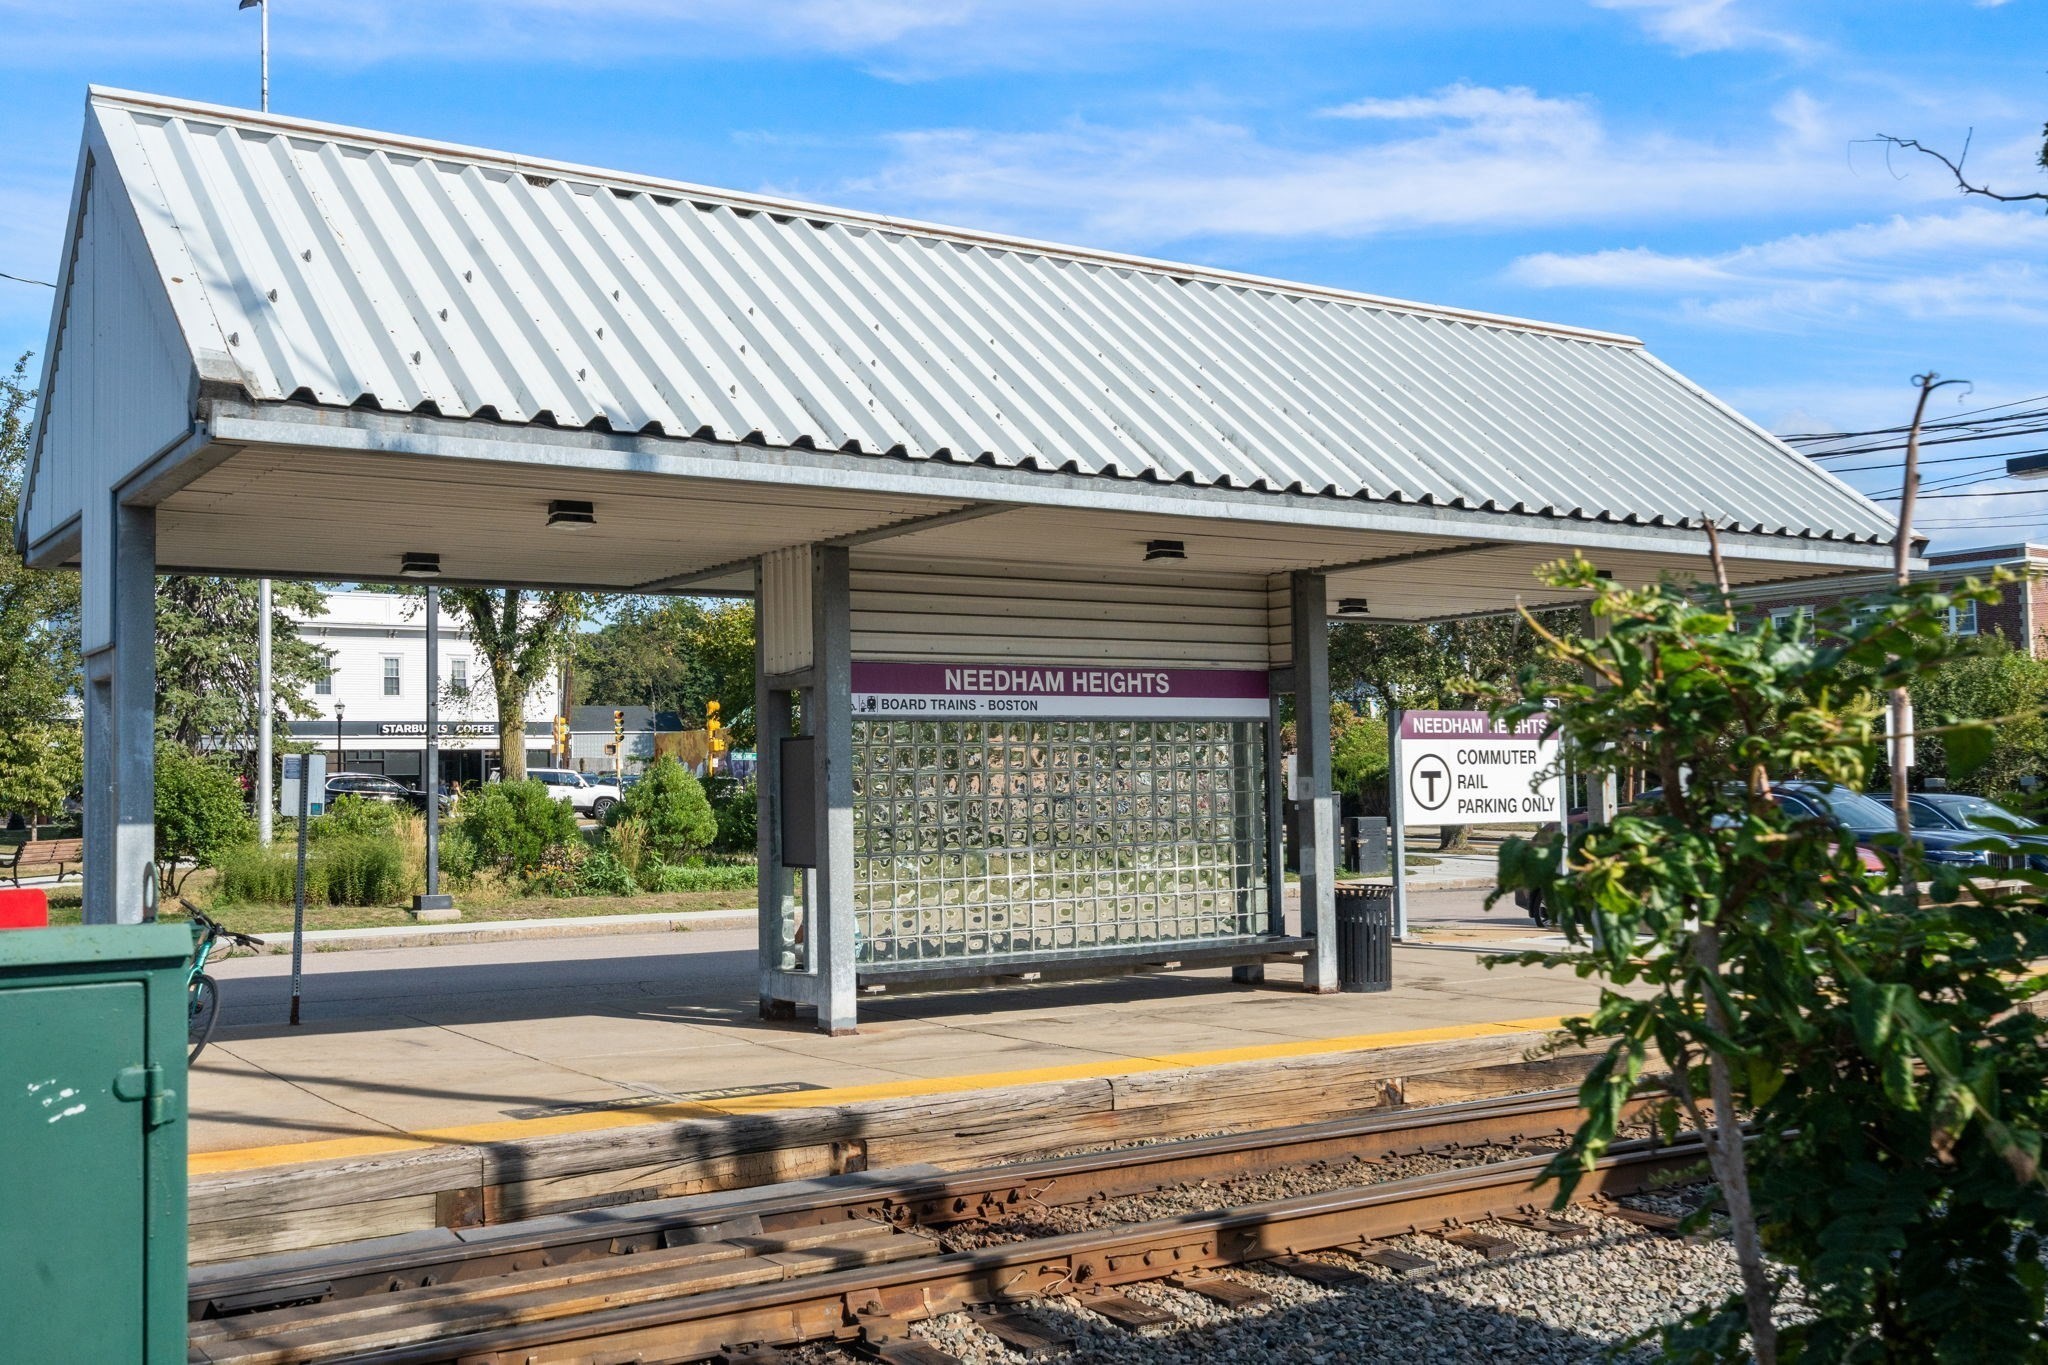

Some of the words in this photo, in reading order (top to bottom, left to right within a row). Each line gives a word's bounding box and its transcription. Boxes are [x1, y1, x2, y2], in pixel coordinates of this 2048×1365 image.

[944, 668, 1065, 692] NEEDHAM
[1072, 672, 1170, 694] HEIGHTS
[881, 698, 927, 710] BOARD
[930, 699, 976, 711] TRAINS
[988, 699, 1038, 711] BOSTON
[382, 724, 449, 734] STARBUS
[455, 724, 495, 733] COFFEE
[1413, 717, 1483, 734] NEEDHAM
[1488, 718, 1548, 734] HEGHTS
[1457, 749, 1537, 765] COMMUTER
[1420, 770, 1442, 802] T
[1457, 774, 1488, 789] RAIL
[1458, 797, 1517, 813] PARKING
[1522, 797, 1555, 812] ONLY
